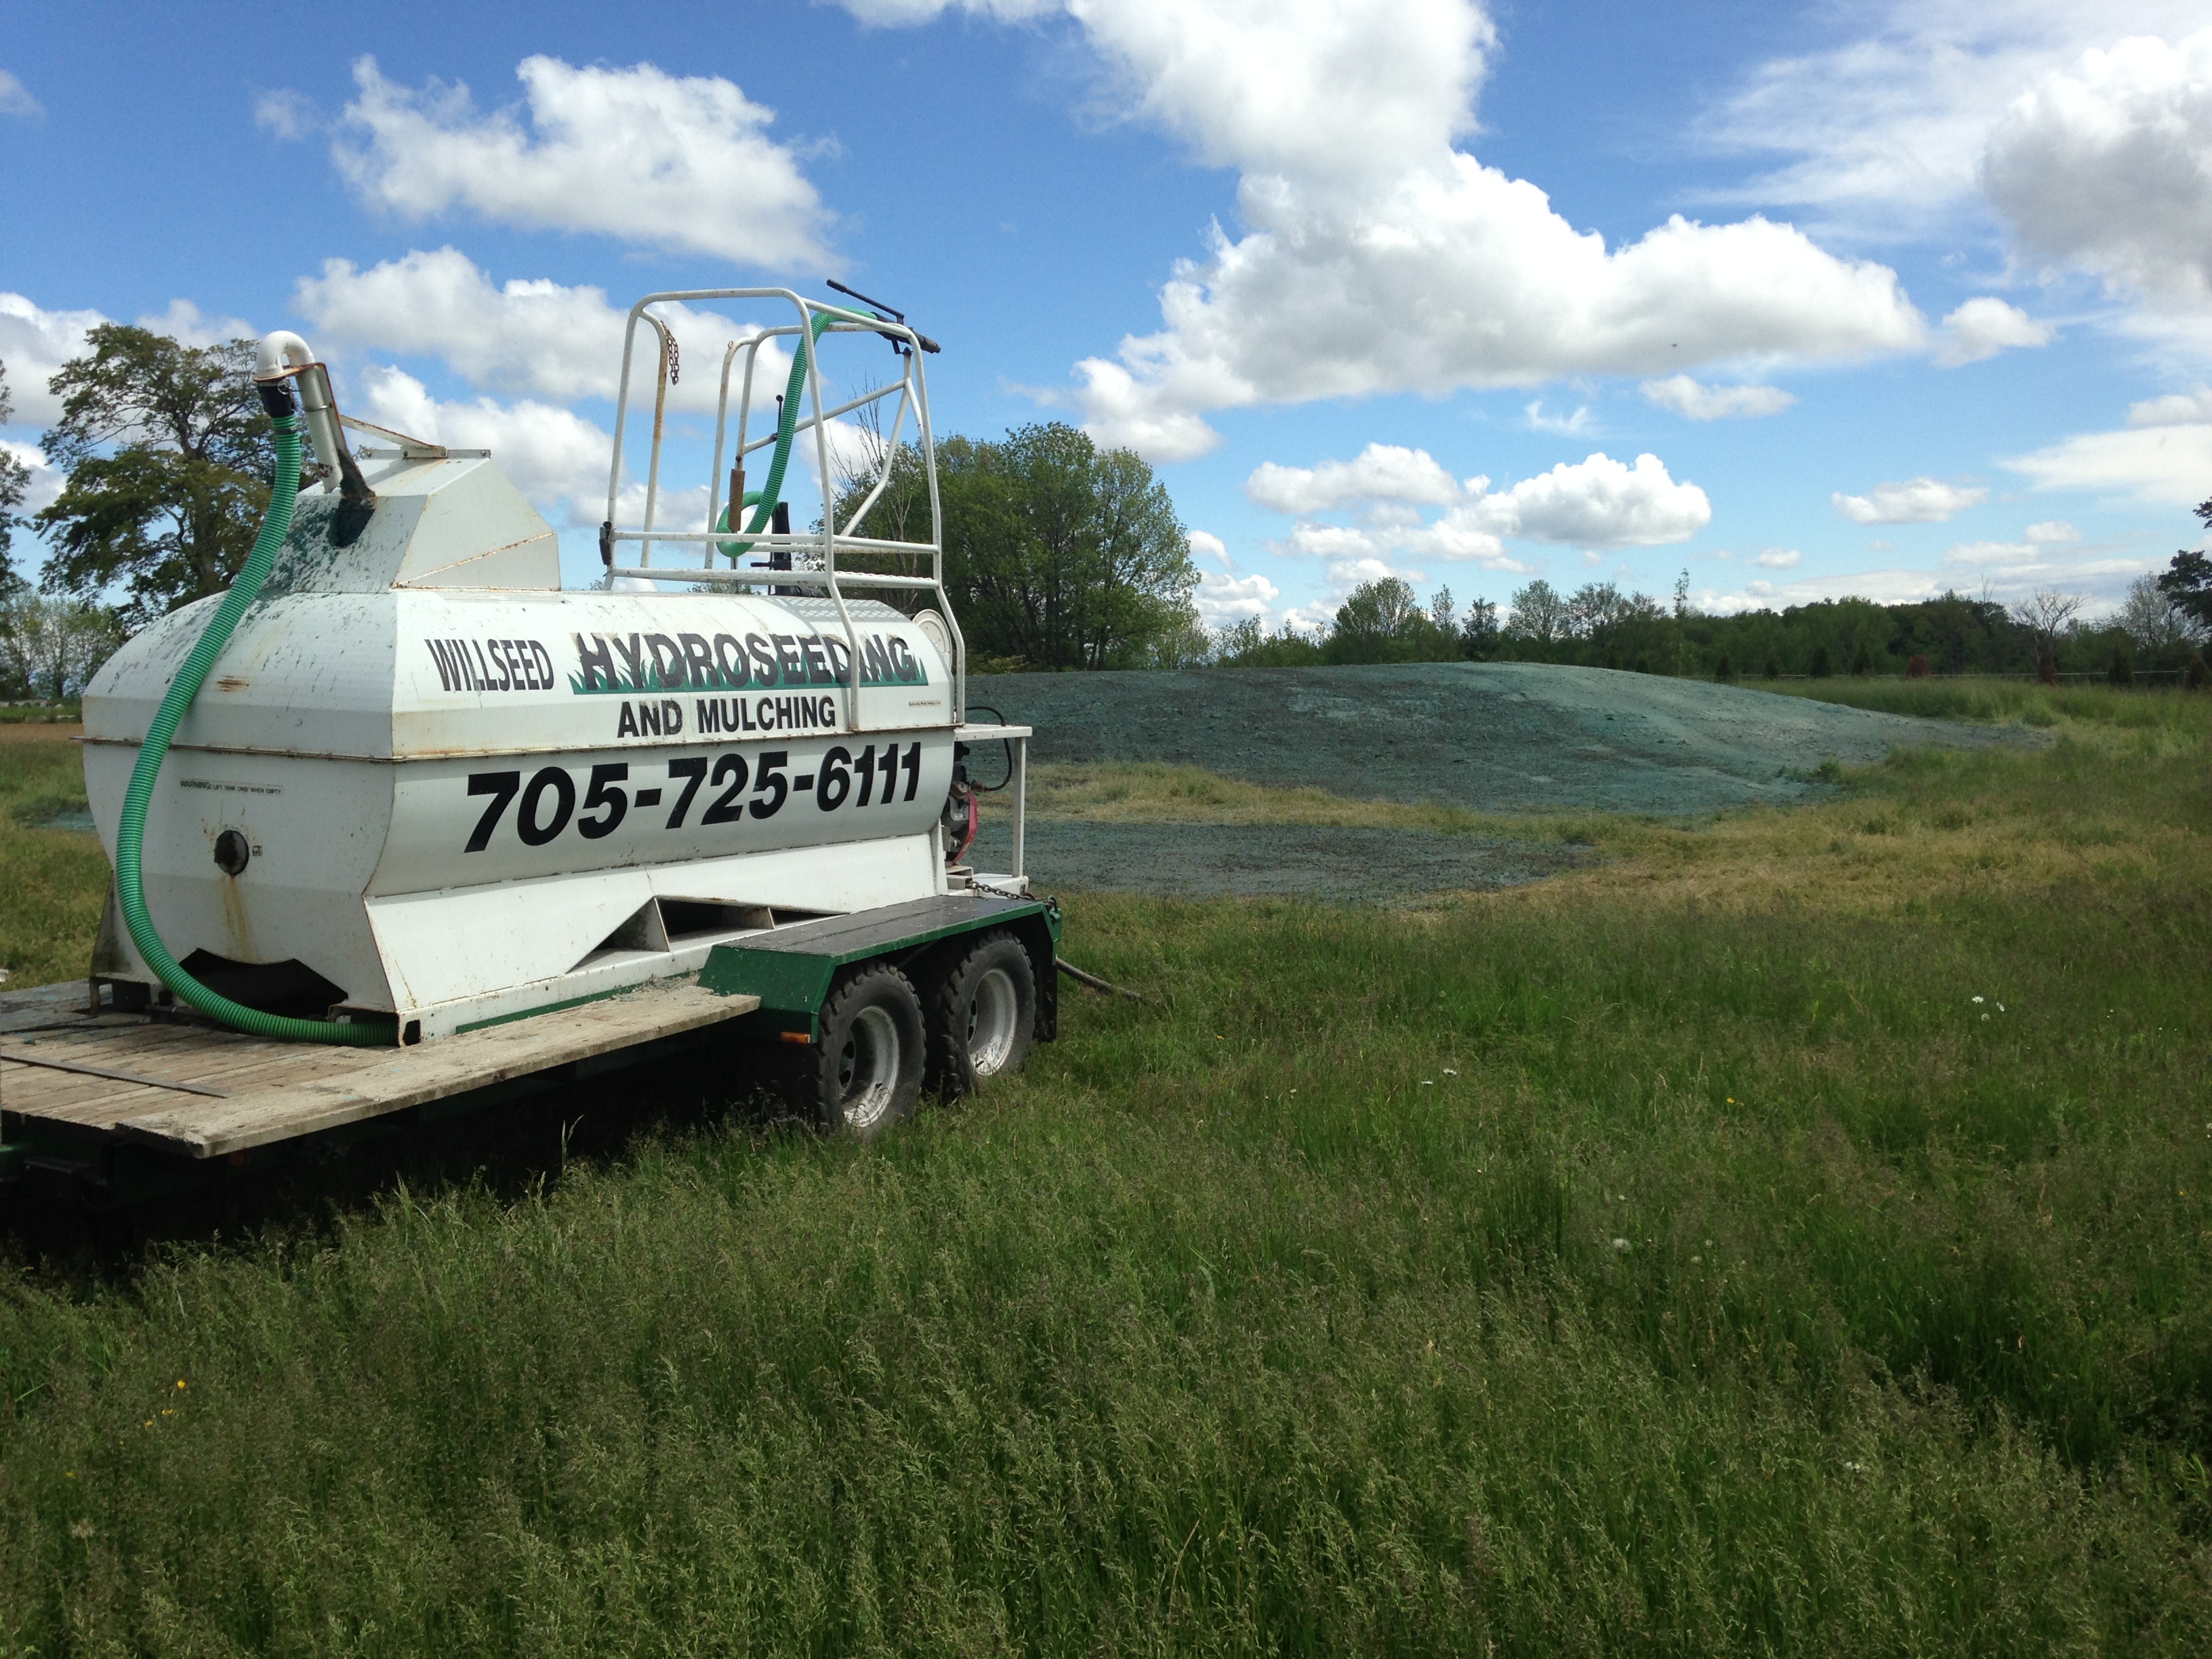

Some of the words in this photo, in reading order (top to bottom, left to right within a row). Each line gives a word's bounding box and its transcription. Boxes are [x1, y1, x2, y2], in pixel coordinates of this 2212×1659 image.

[424, 638, 554, 692] WILLSEED
[569, 632, 919, 691] HYDROSEEDING
[617, 701, 683, 739] AND
[696, 695, 837, 734] MULCHING
[463, 741, 922, 854] 705-725-6111
